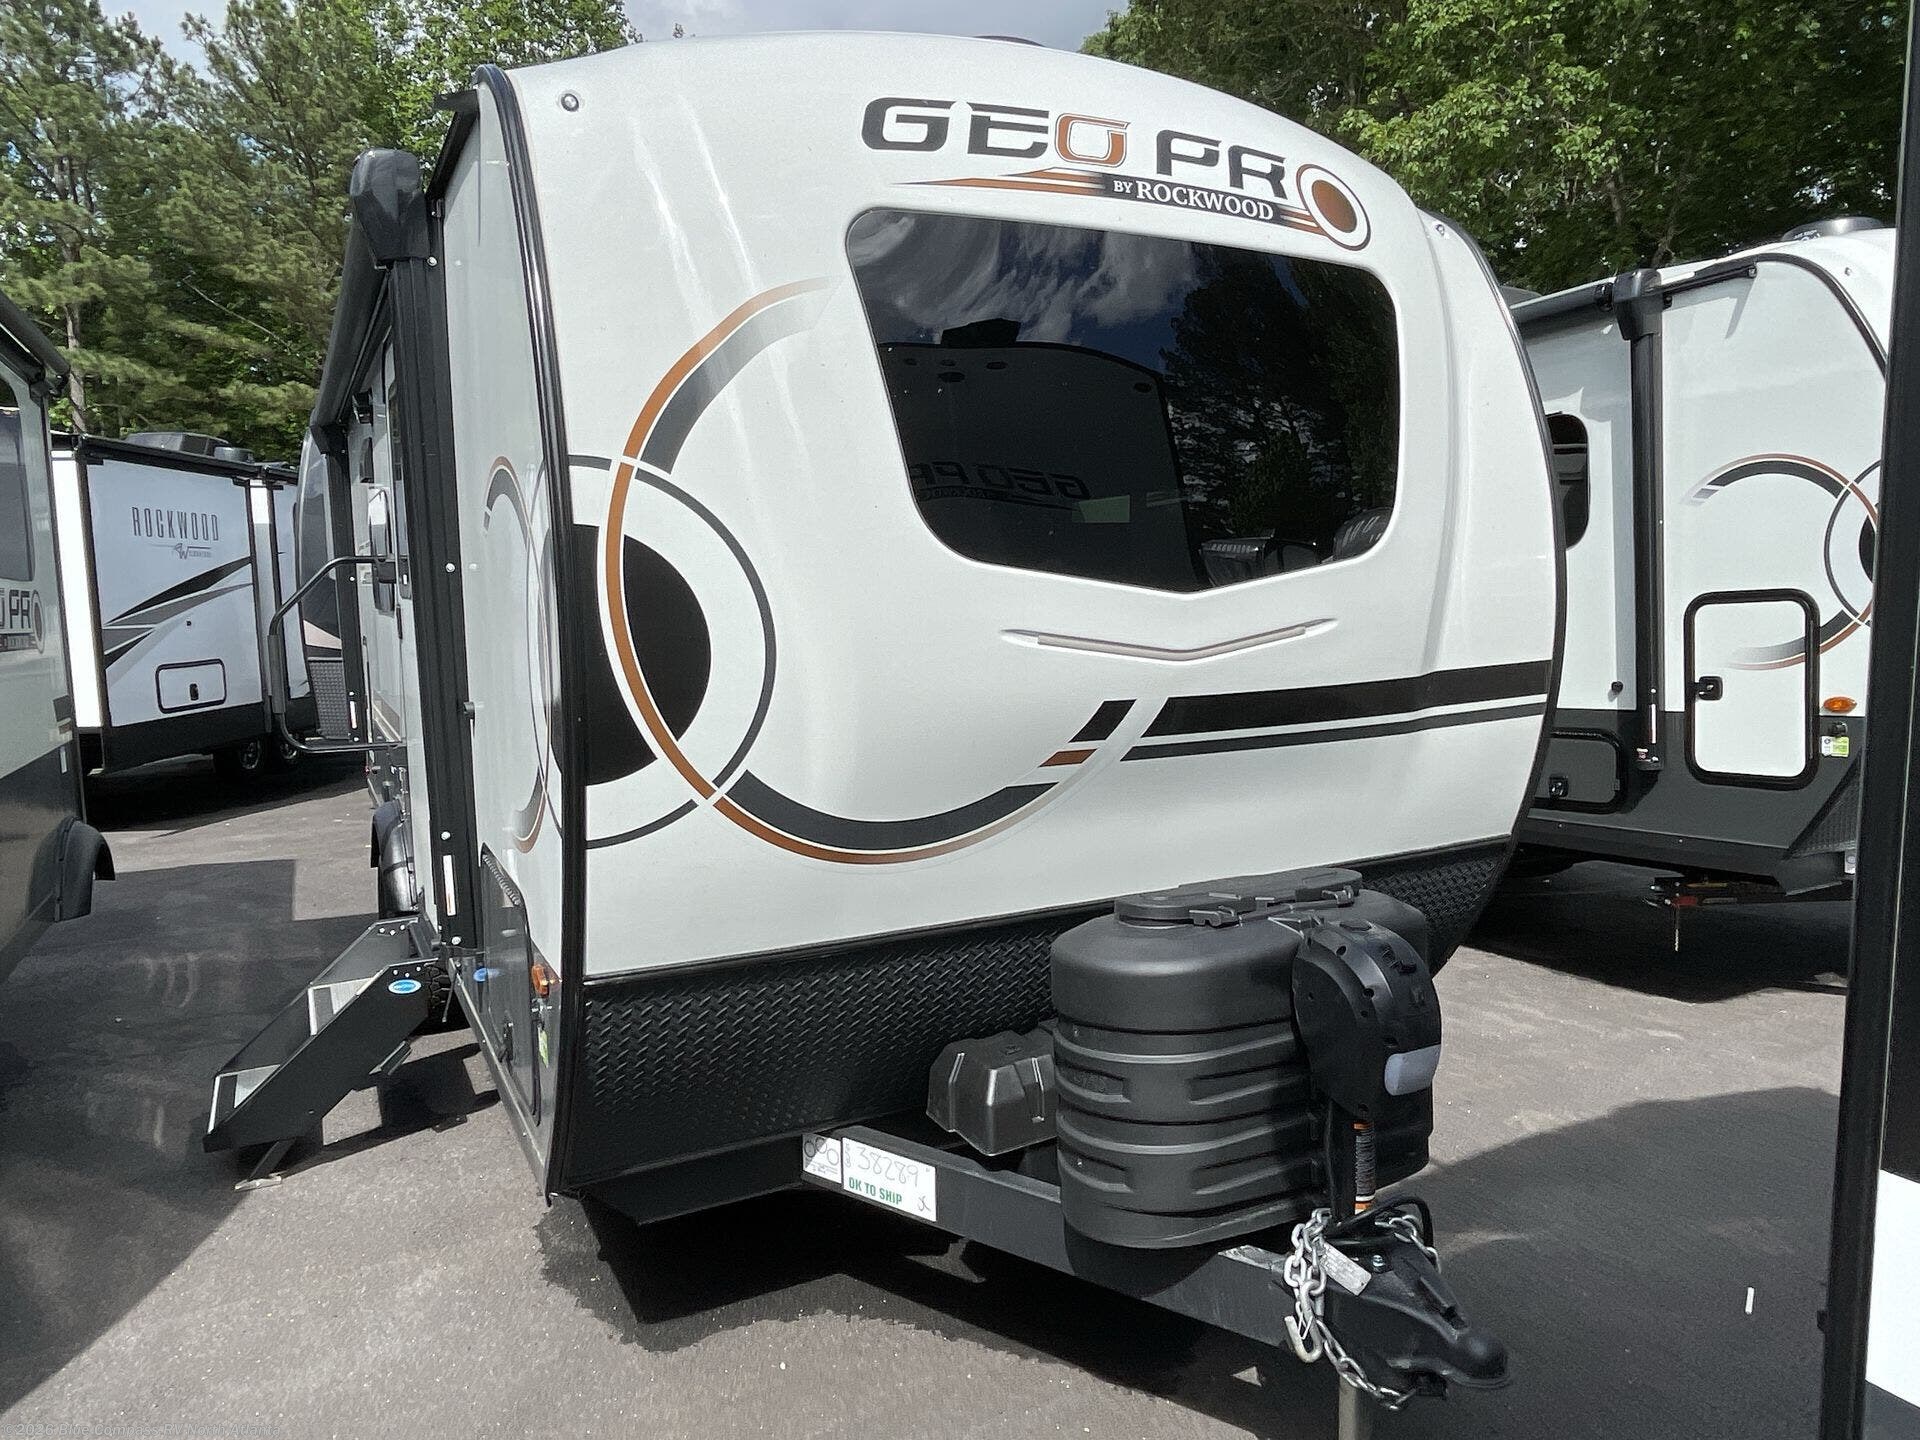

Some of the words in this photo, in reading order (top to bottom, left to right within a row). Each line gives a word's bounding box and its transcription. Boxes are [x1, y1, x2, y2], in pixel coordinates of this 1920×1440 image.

[861, 96, 1131, 168] GEO
[1113, 180, 1132, 195] BY
[1135, 179, 1274, 221] ROCKWOOD
[131, 506, 219, 541] ROCKWOOD
[848, 1176, 862, 1192] OK
[864, 1182, 877, 1197] TO
[879, 1187, 903, 1205] SHIP
